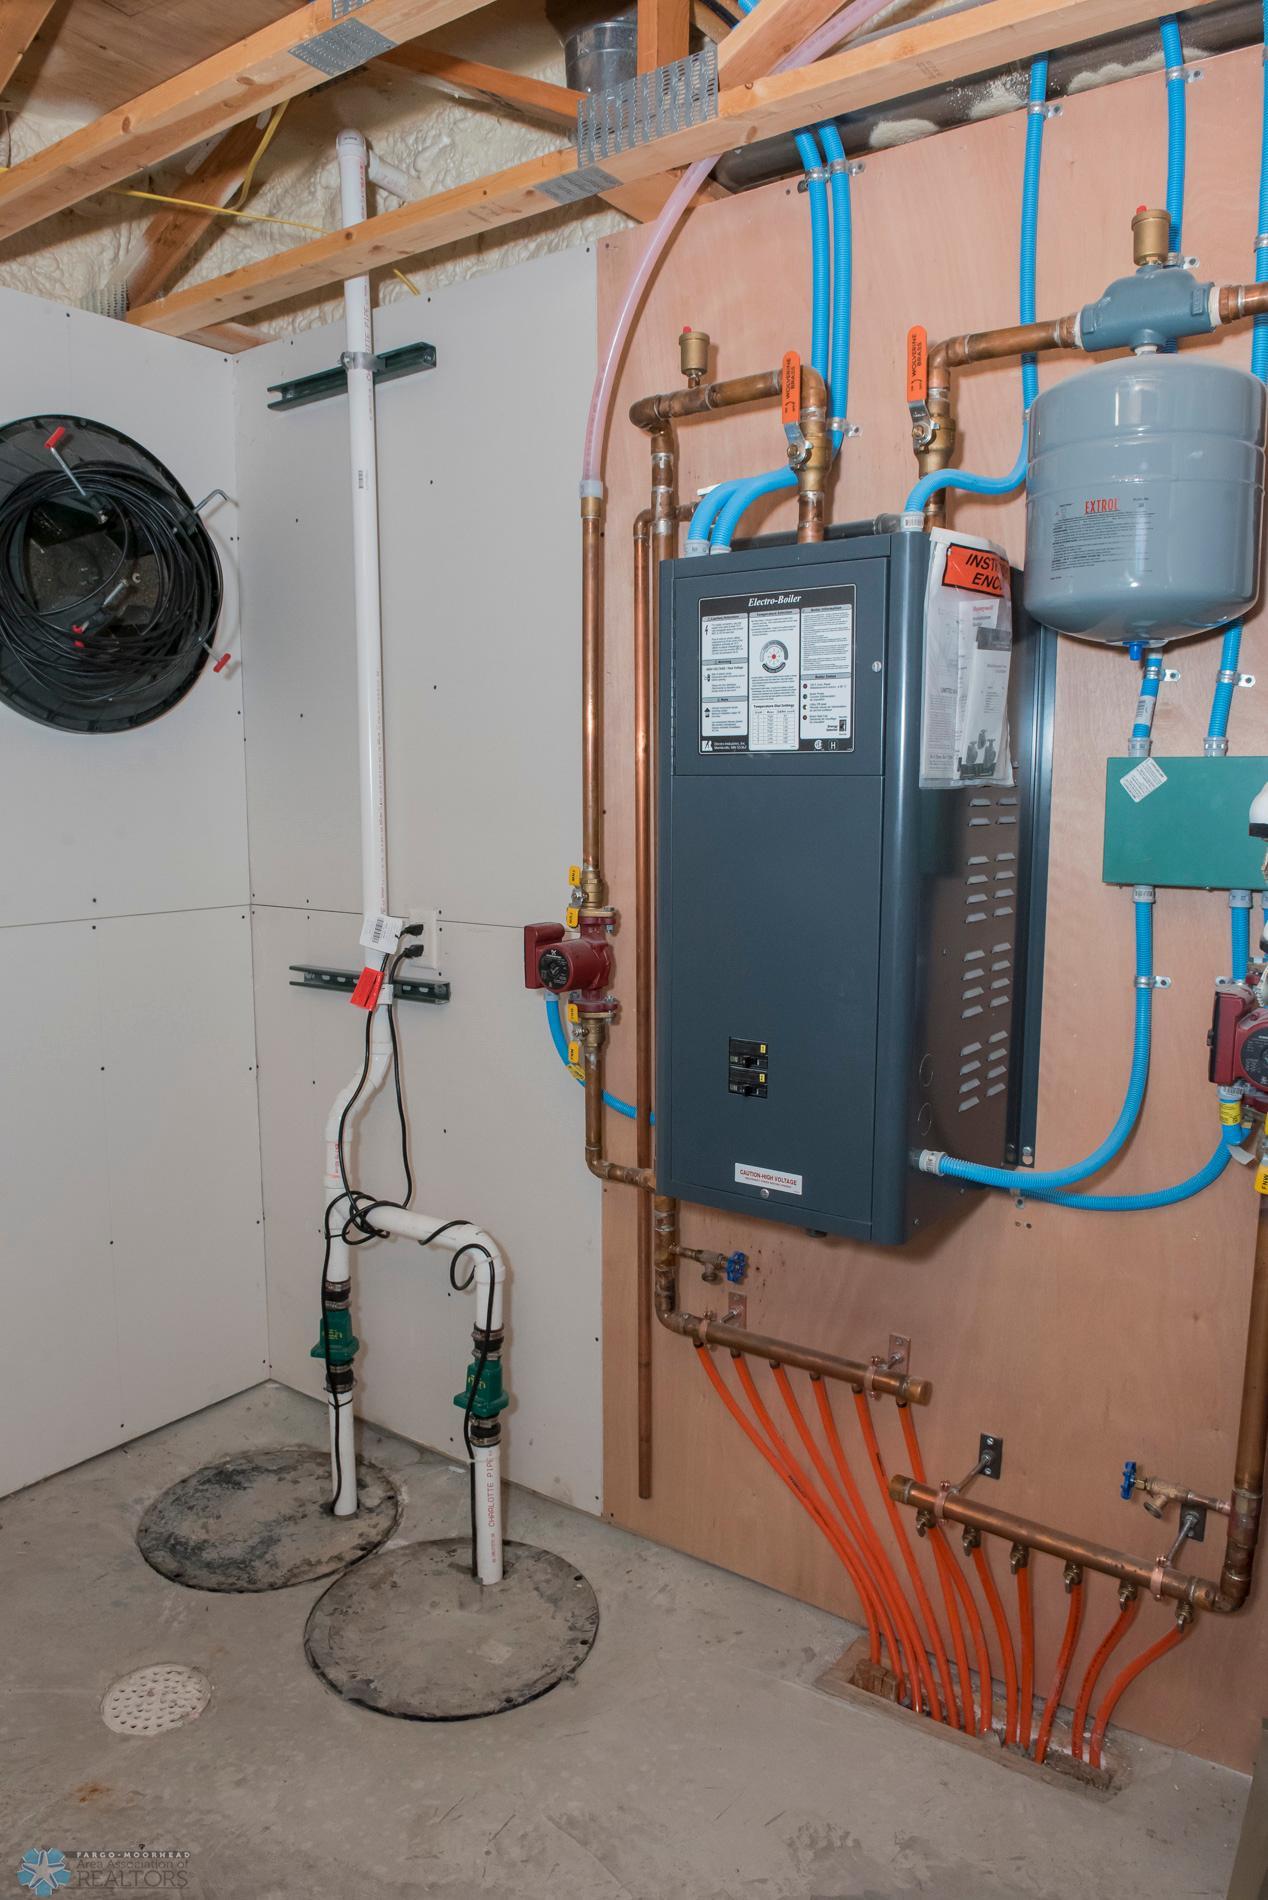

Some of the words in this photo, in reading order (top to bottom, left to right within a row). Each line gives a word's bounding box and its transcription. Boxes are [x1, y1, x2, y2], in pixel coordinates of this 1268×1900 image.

[1085, 498, 1120, 514] EXTROL
[972, 572, 1002, 590] ENC
[748, 594, 802, 607] Electro-Boiler
[774, 1175, 797, 1185] VOLTAGE
[487, 1482, 495, 1527] CHARLOTTE
